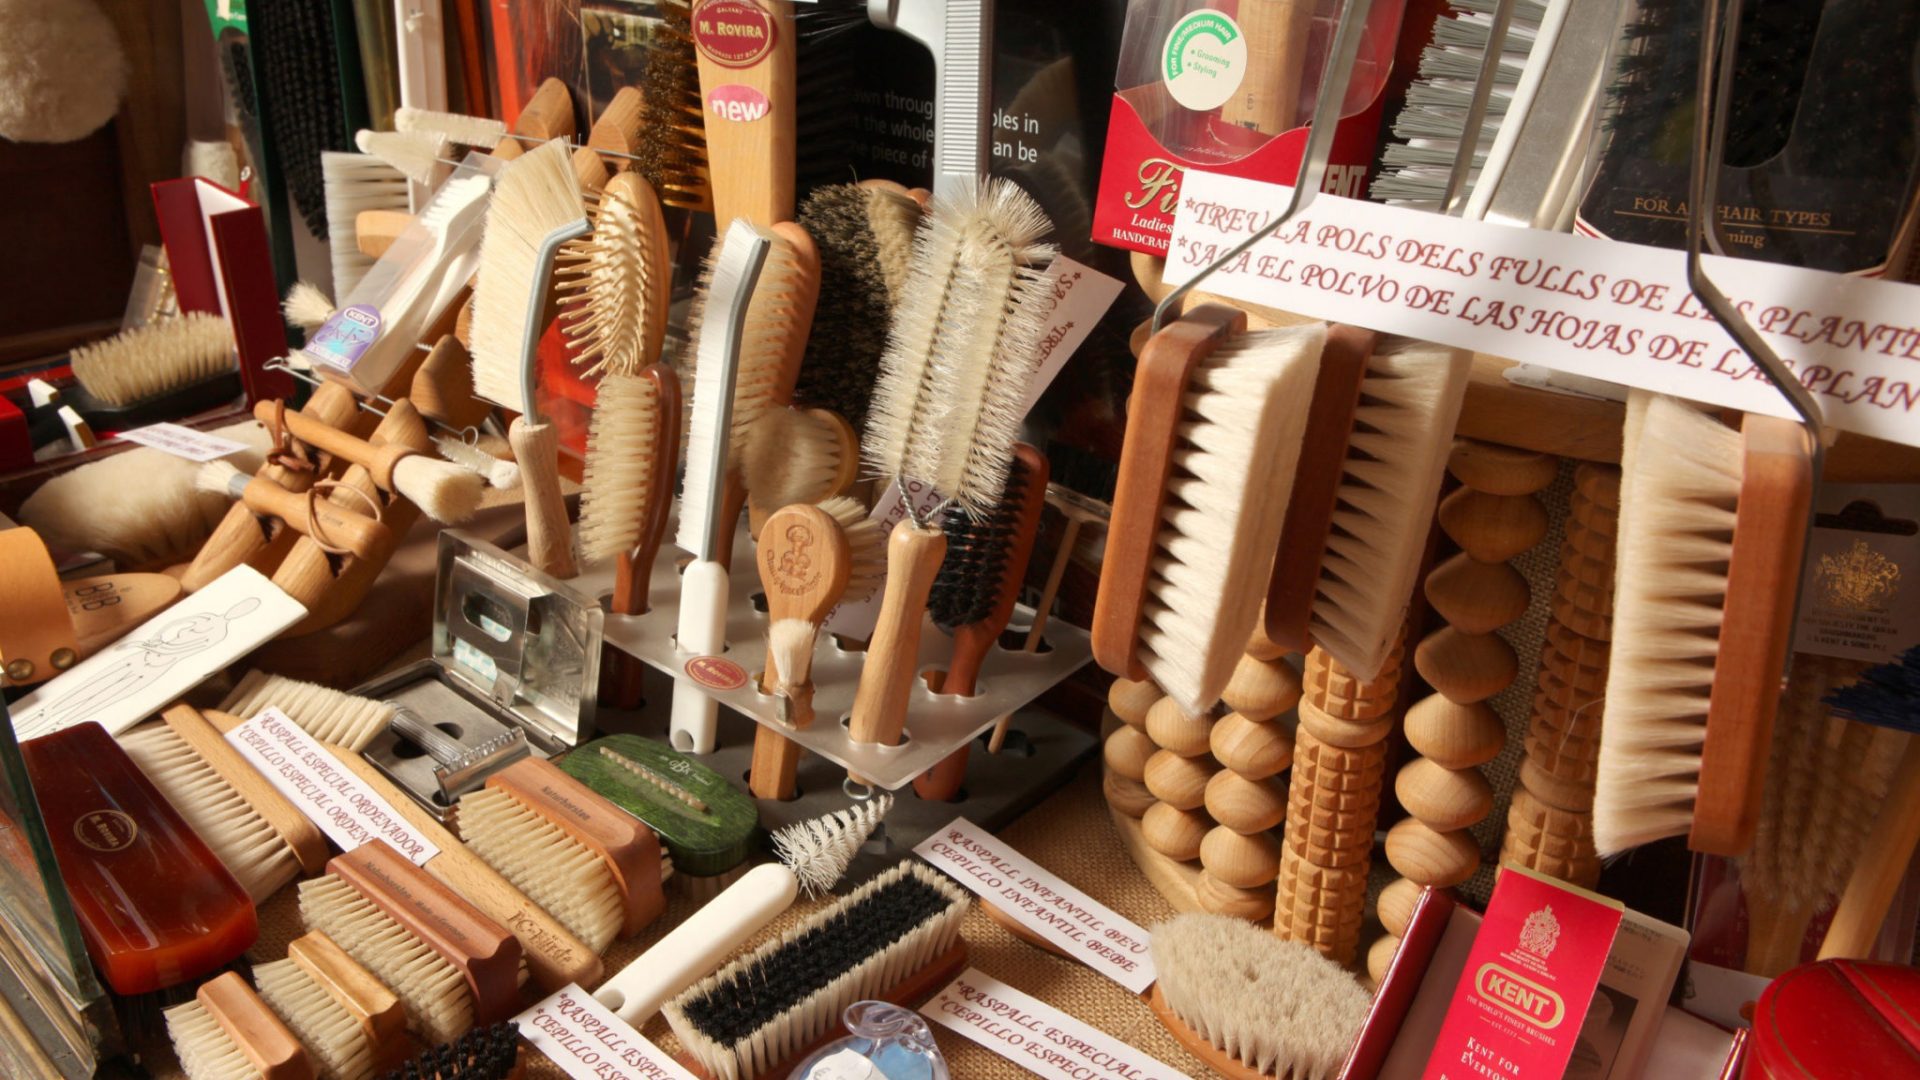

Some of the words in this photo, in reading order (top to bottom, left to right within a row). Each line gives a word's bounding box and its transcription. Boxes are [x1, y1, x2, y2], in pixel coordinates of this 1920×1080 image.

[700, 20, 714, 35] M.
[717, 21, 764, 39] ROVIRA
[1170, 57, 1178, 76] FOR
[1192, 61, 1217, 79] Styling
[1197, 49, 1231, 69] Grooming
[711, 99, 764, 122] new
[885, 89, 934, 120] throug
[993, 108, 1019, 131] oles
[1024, 113, 1039, 135] in
[891, 120, 935, 144] whole
[992, 140, 1012, 158] an
[1018, 140, 1038, 163] be
[911, 150, 928, 169] of
[1124, 158, 1182, 214] Fi
[1323, 164, 1367, 200] ENT
[1634, 197, 1670, 213] FOR
[1771, 209, 1831, 227] TYPES
[1112, 228, 1171, 251] HANDCRAF
[1317, 224, 1393, 260] POLS
[1396, 239, 1484, 277] DELS
[1490, 256, 1607, 301] FULLS
[1611, 279, 1670, 312] DE
[346, 310, 376, 327] KENT
[1257, 255, 1295, 283] EL
[1301, 264, 1400, 303] POLVO
[1405, 285, 1455, 316] DE
[1457, 297, 1525, 331] LAS
[1525, 310, 1644, 356] HOJAS
[1648, 335, 1709, 368] DE
[238, 728, 286, 767] CEPILLO
[279, 762, 330, 810] ESPECIAL
[326, 805, 375, 847] ORDEN
[259, 716, 308, 756] RASPALL
[302, 751, 356, 797] ESPECIAL
[349, 793, 425, 862] ORDENADOR
[930, 841, 1003, 889] CEPILLO
[1000, 887, 1089, 943] INFANTIL
[1085, 939, 1139, 974] BEBE
[948, 828, 1021, 881] RASPALL
[1019, 876, 1106, 932] INFANTIL
[1104, 927, 1149, 955] BEU
[1487, 973, 1550, 1016] KENT
[532, 1012, 601, 1066] CEPILLO
[557, 998, 628, 1052] RASPALL
[940, 1000, 1026, 1046] CEPILLO
[957, 984, 1045, 1032] RASPALL
[1042, 1026, 1144, 1080] ESPECIAL
[1504, 1015, 1526, 1030] FINEST
[1525, 1025, 1557, 1047] BRUSHES
[1498, 1056, 1520, 1076] FOR
